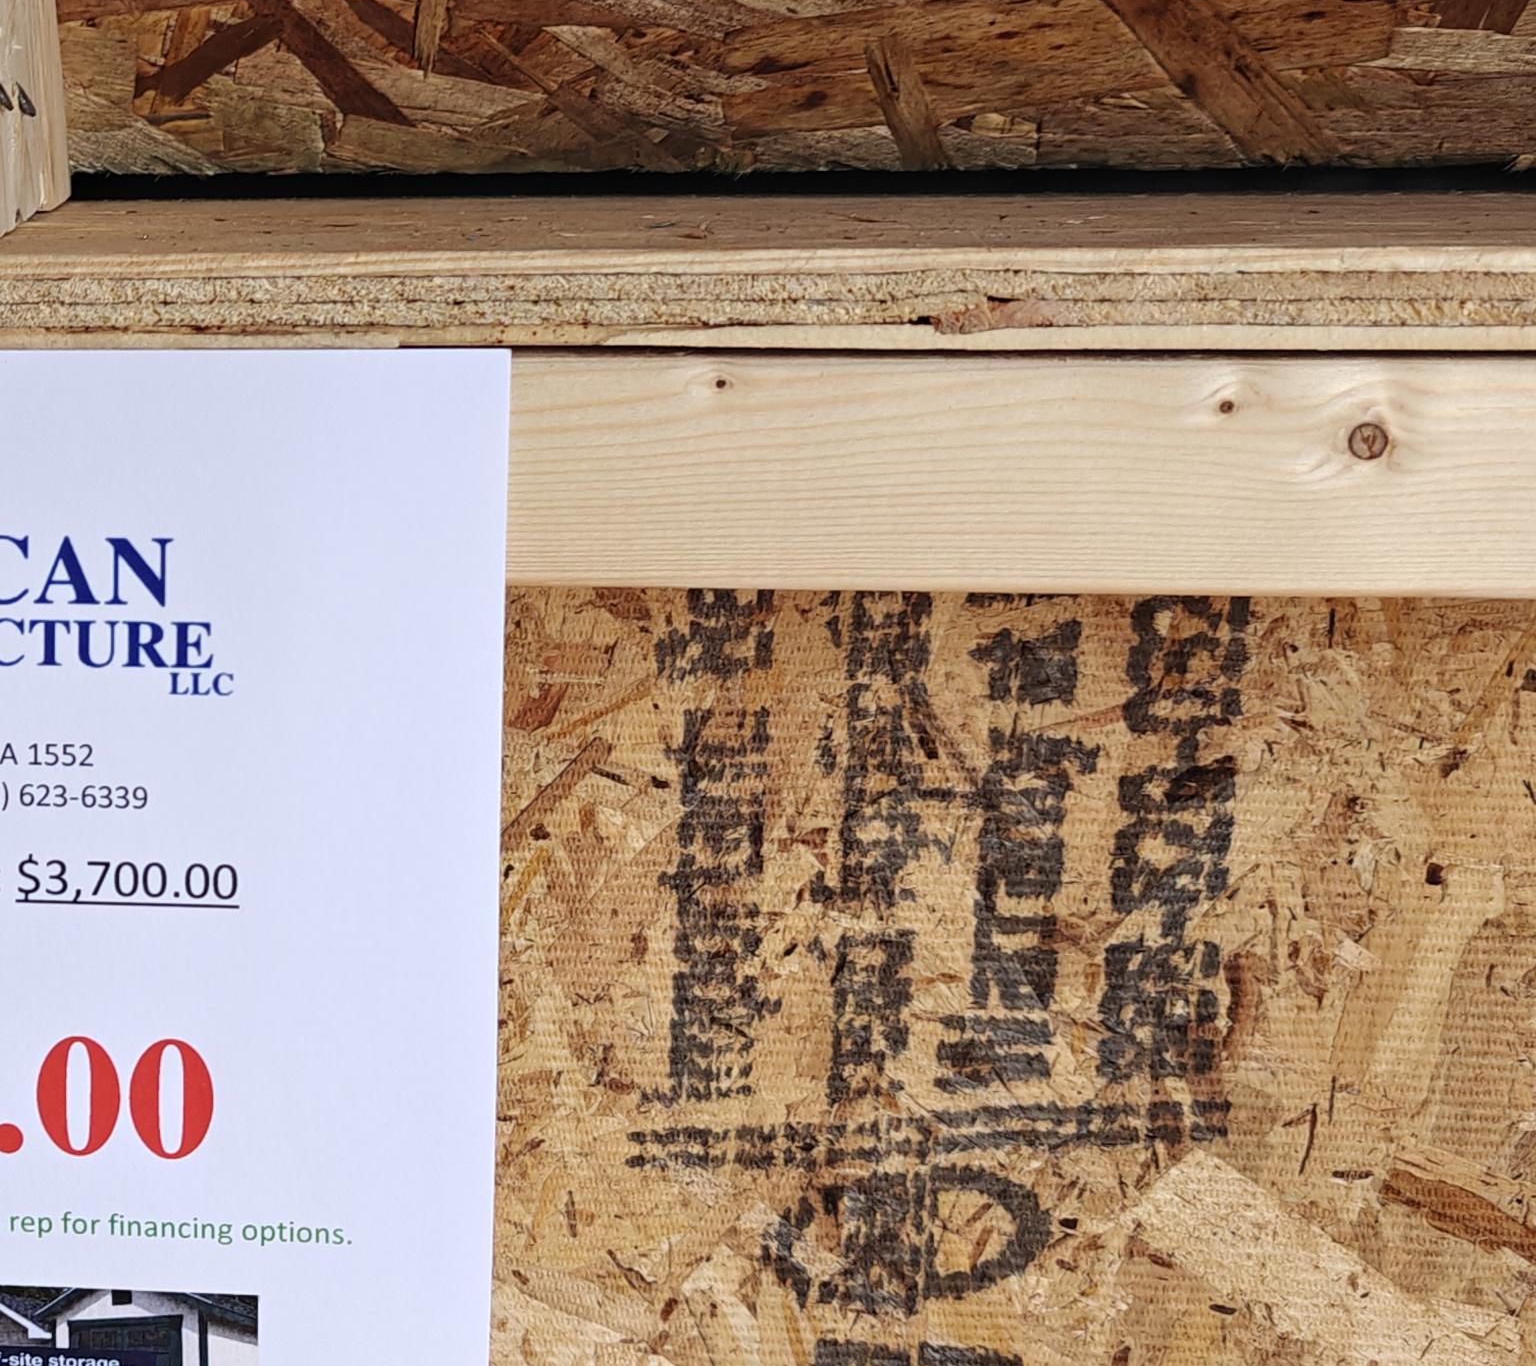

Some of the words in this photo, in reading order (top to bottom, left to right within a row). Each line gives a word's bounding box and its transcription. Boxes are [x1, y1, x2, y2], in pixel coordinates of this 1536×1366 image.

[169, 672, 234, 696] LLC
[29, 743, 93, 767] 1552
[20, 784, 147, 809] 623-6339
[15, 853, 240, 909] $3,700.00
[10, 1216, 52, 1238] rep
[61, 1211, 100, 1234] for
[108, 1213, 232, 1245] financing
[242, 1222, 351, 1246] options.
